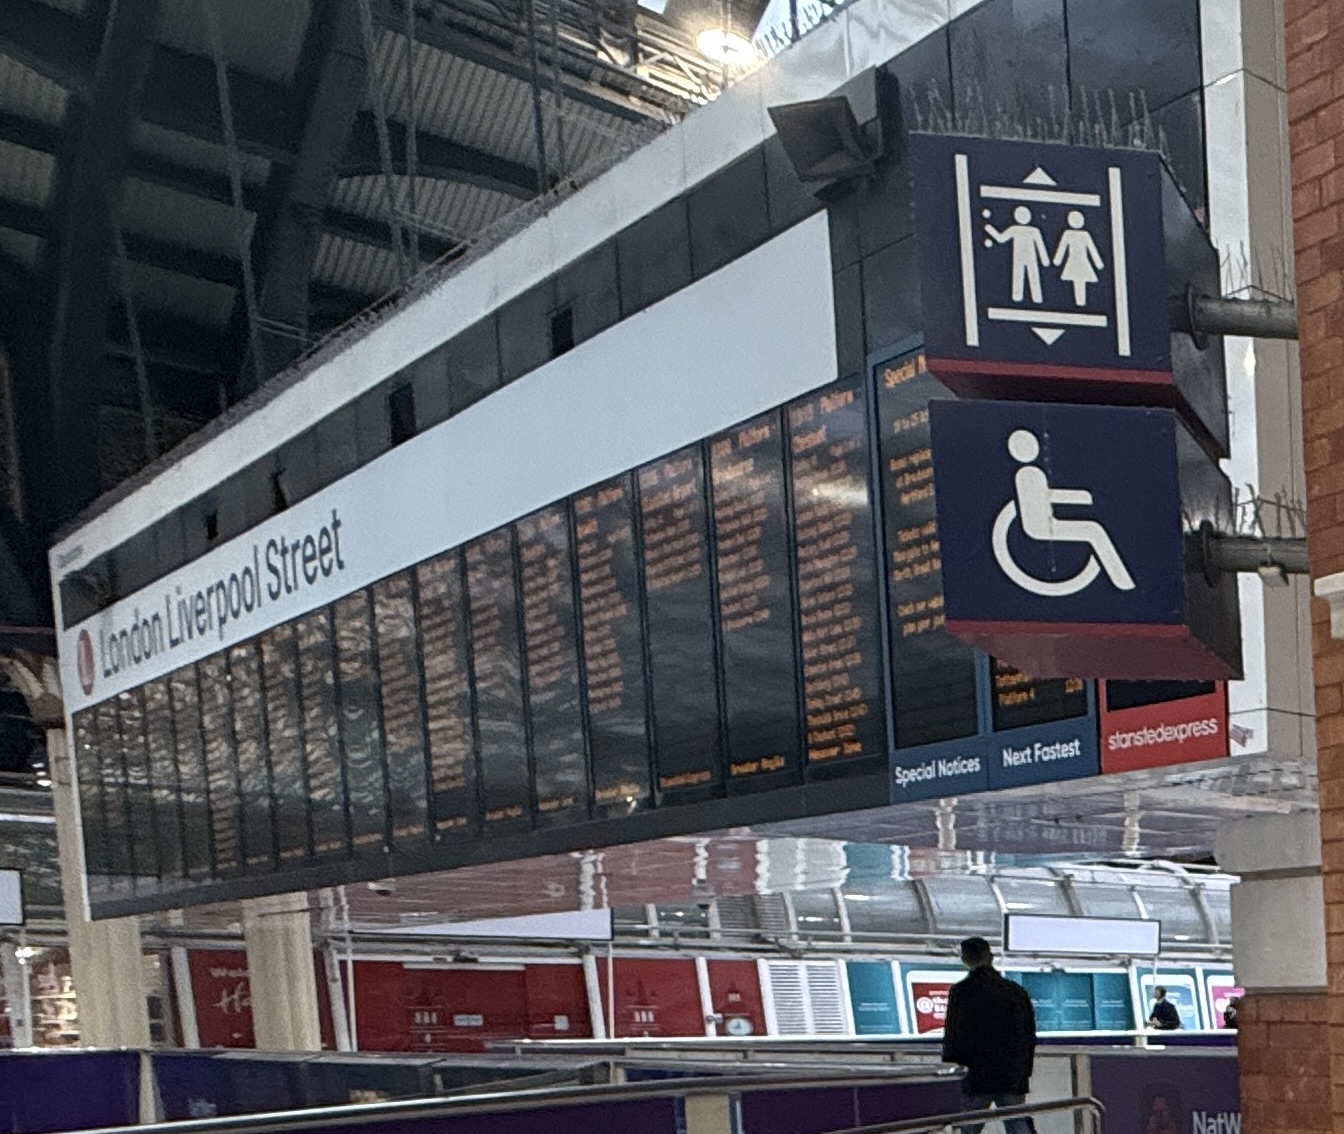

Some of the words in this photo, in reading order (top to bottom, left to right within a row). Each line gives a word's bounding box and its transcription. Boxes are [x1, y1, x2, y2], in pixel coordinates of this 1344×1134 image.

[100, 606, 165, 678] London
[165, 545, 262, 648] Liverpool
[266, 508, 345, 600] Street
[1108, 717, 1218, 750] stanstedexpress
[1003, 747, 1032, 767] Next
[1034, 738, 1081, 763] Fastest
[895, 760, 936, 787] Special
[938, 756, 981, 778] Notices
